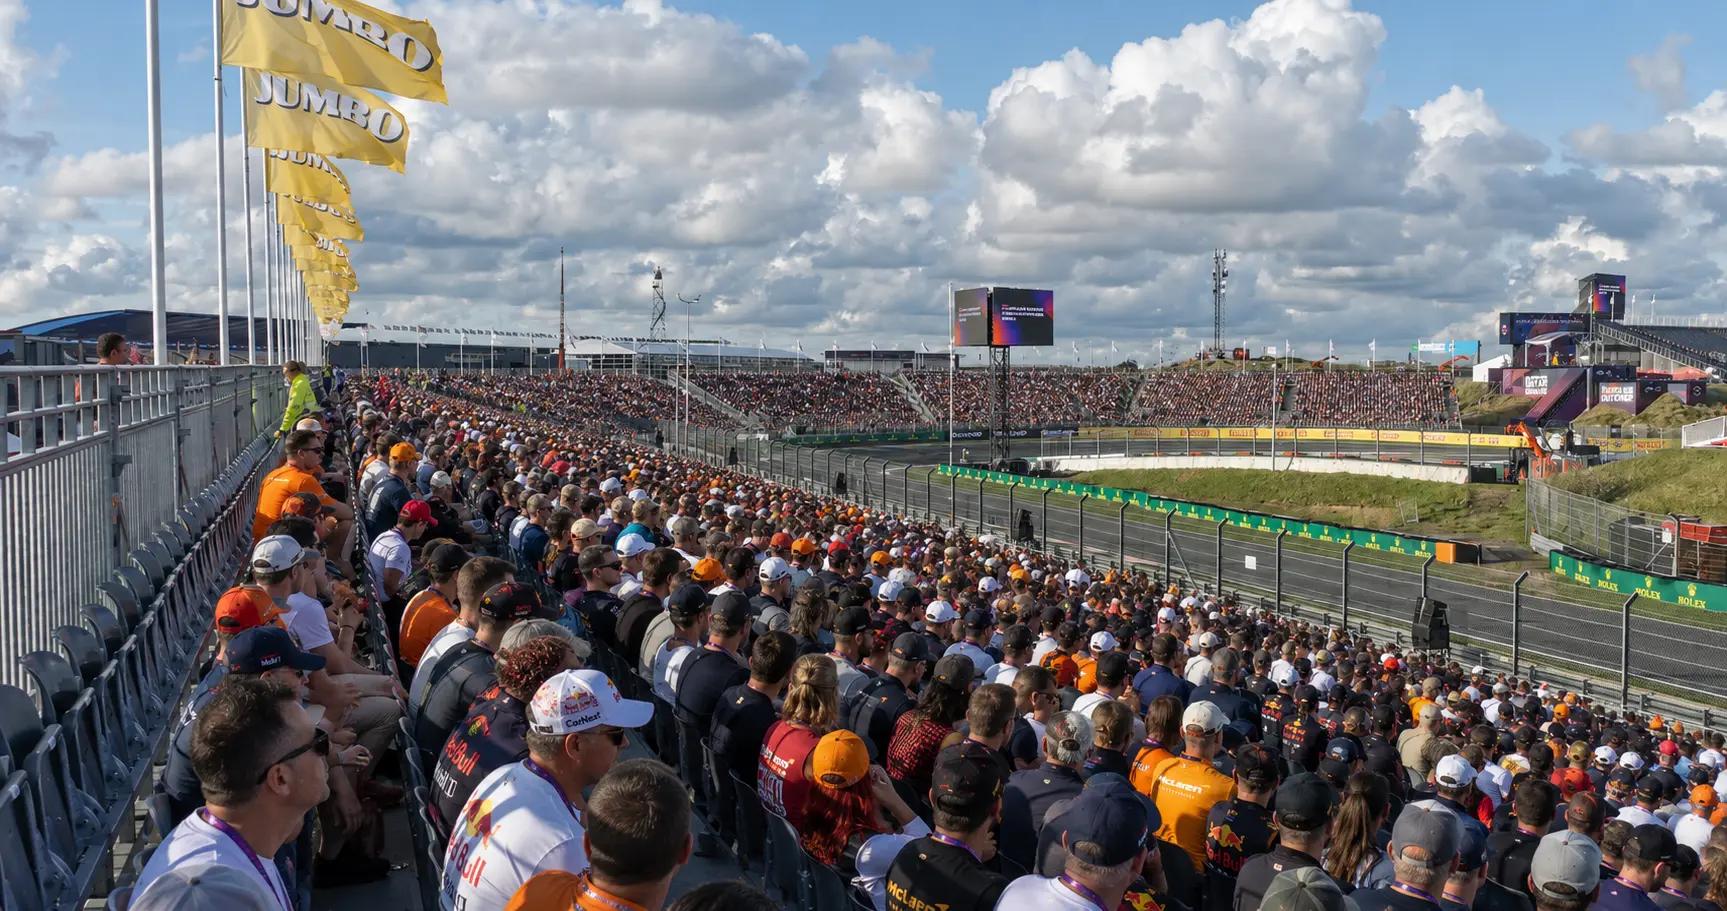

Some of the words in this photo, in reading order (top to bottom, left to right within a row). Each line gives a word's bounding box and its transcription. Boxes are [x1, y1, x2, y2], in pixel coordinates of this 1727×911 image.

[237, 0, 434, 72] MBO
[255, 72, 404, 143] JUMBO
[1678, 595, 1706, 609] ROLEX
